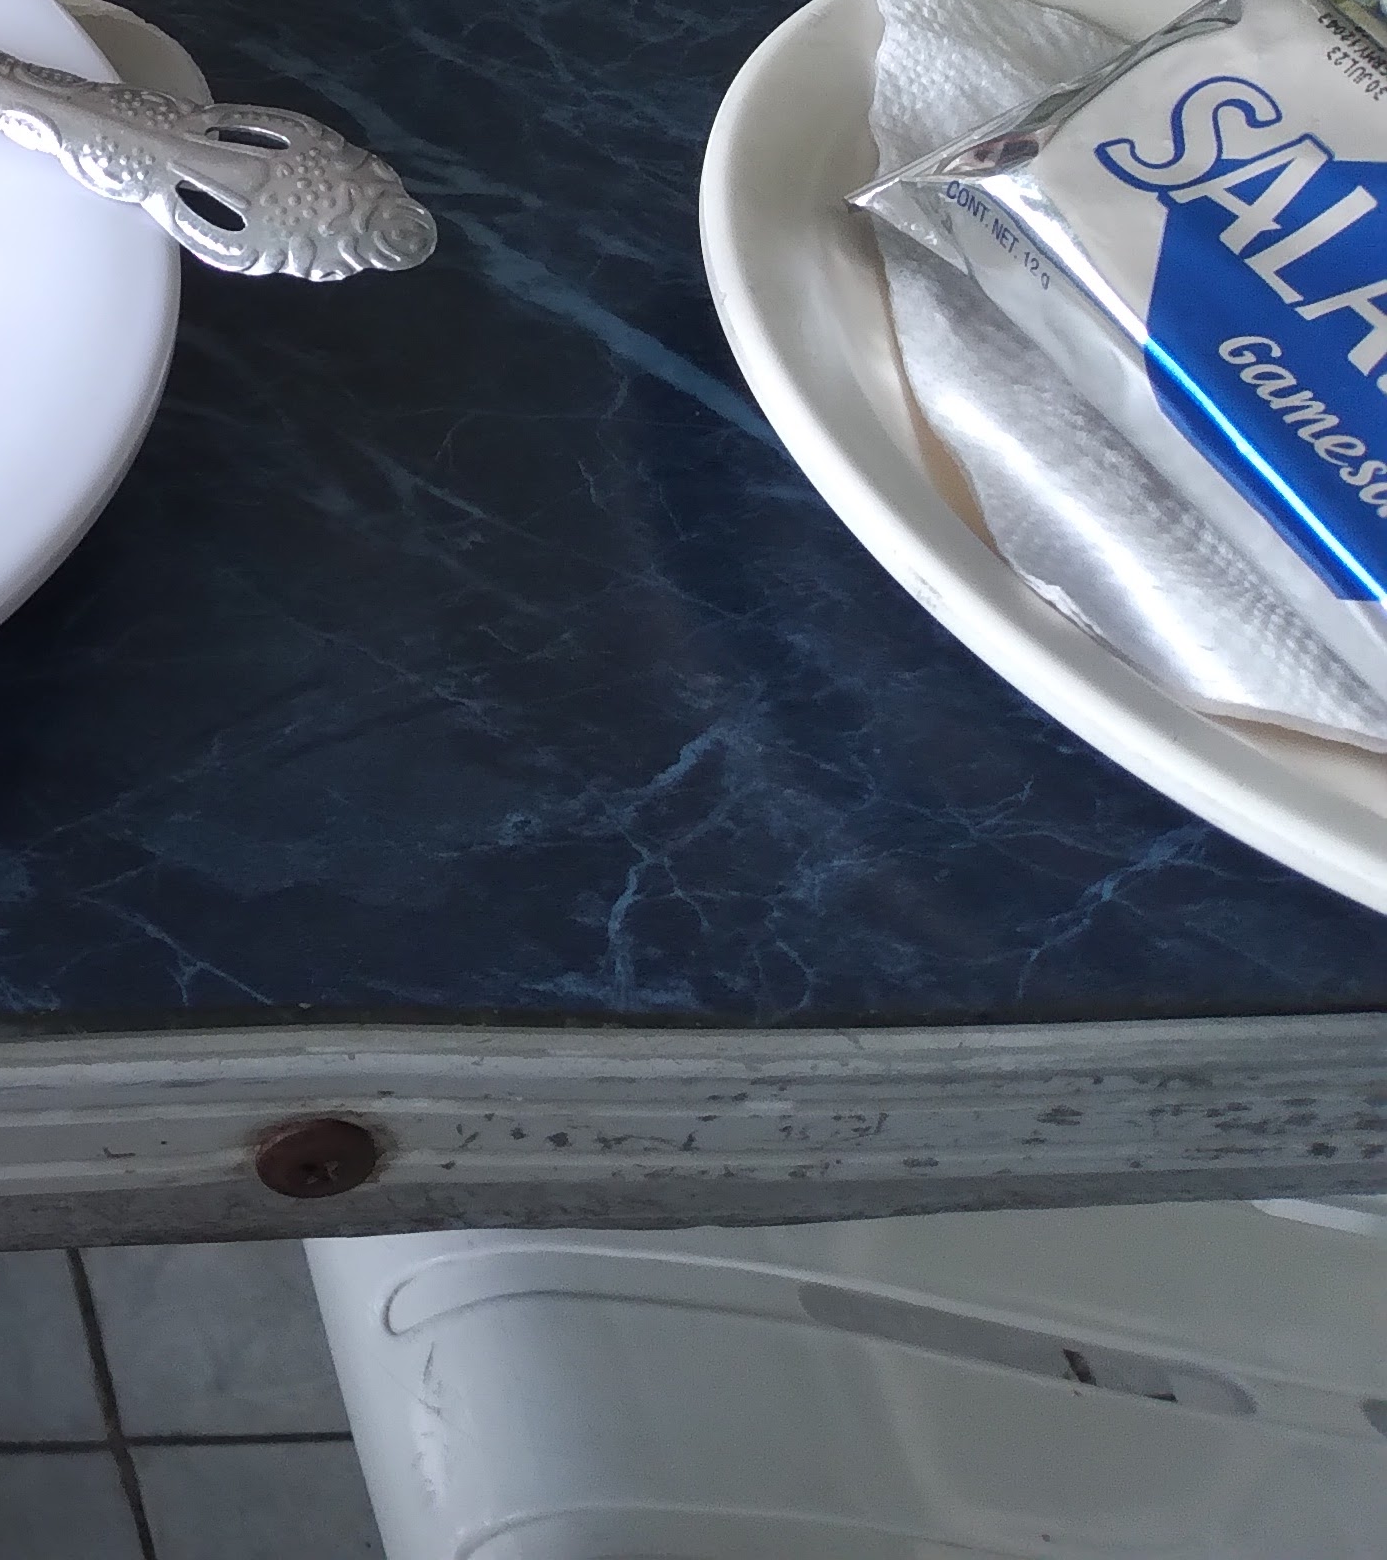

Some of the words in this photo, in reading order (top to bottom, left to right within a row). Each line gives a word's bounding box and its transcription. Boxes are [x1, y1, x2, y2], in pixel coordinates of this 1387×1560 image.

[946, 180, 992, 228] CONT.
[991, 218, 1020, 259] NET.
[1023, 251, 1040, 277] 12
[1093, 75, 1387, 395] SALA
